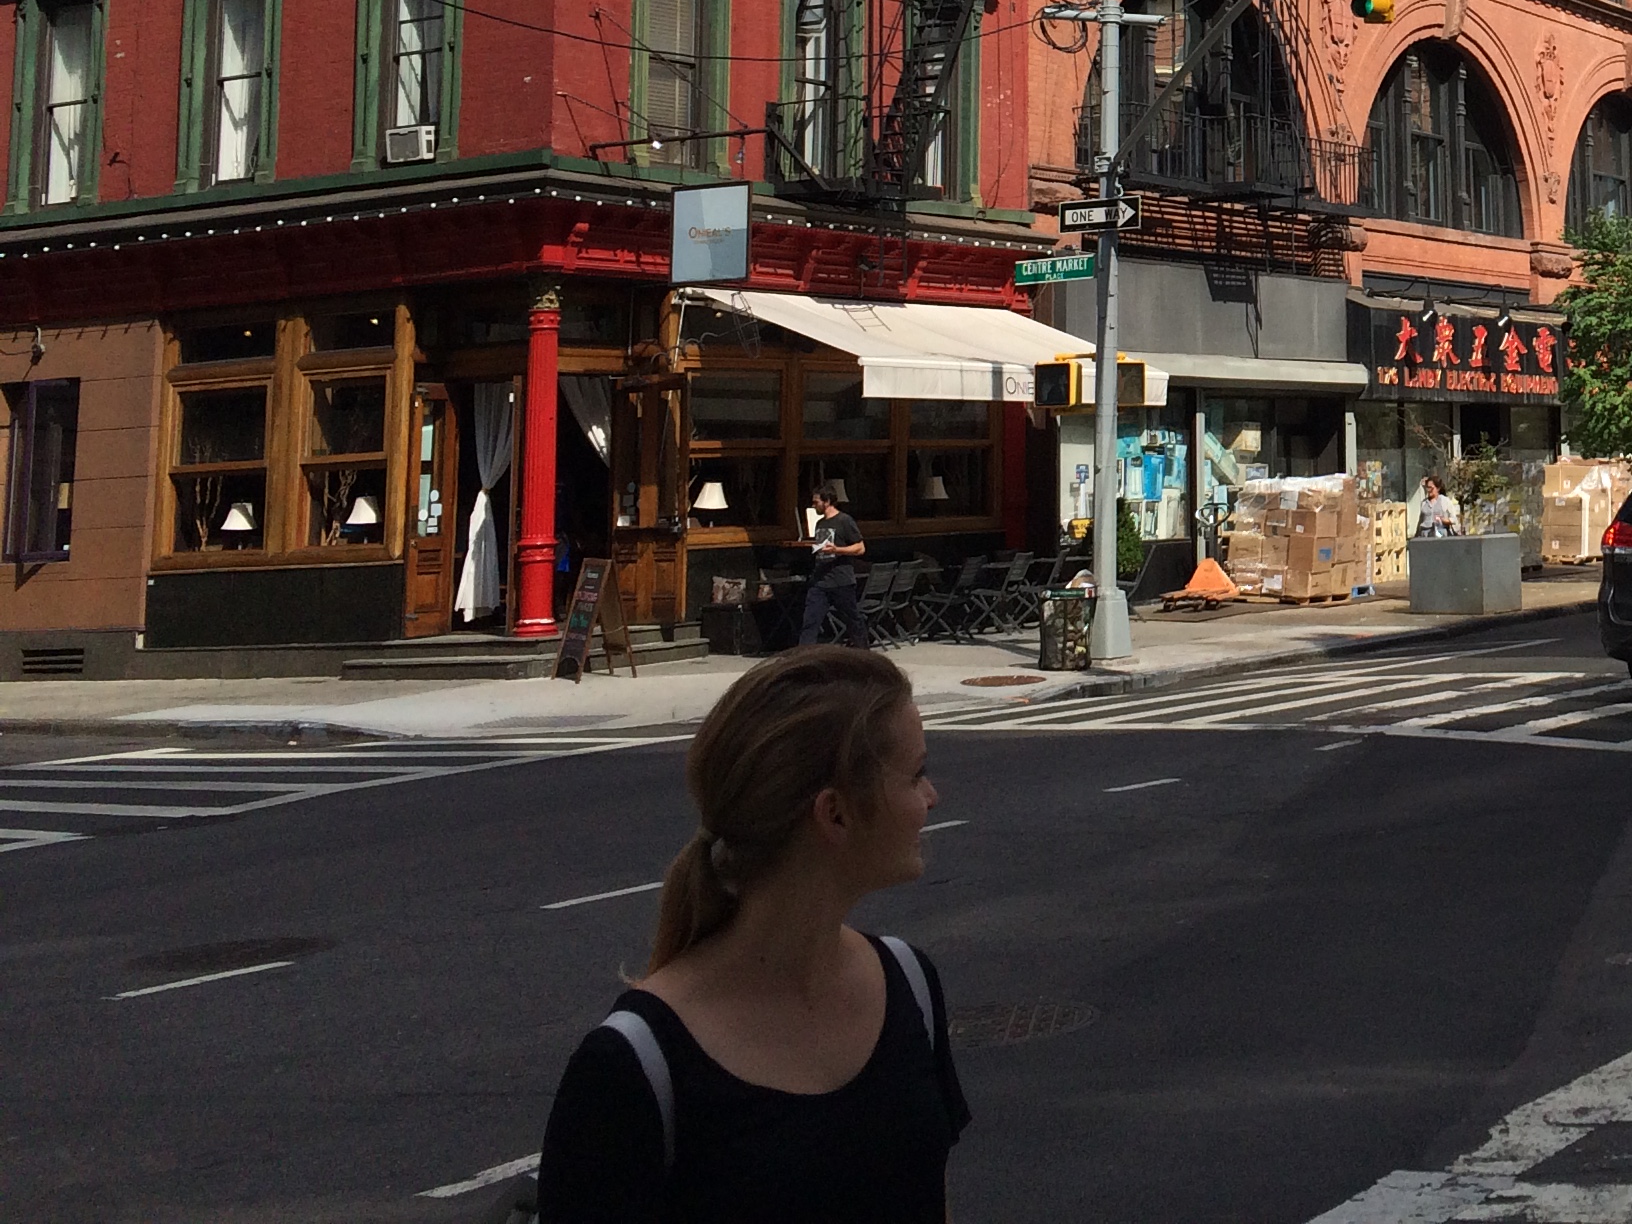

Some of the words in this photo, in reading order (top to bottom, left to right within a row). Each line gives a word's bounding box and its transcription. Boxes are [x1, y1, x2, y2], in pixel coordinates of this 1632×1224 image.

[1071, 210, 1094, 223] ONE
[1104, 207, 1128, 221] WAY
[1022, 261, 1053, 276] CENTRE
[1056, 257, 1089, 272] MARKET
[1045, 273, 1065, 281] PLACE
[1005, 376, 1035, 395] ONIE
[1377, 366, 1399, 385] 176
[1446, 369, 1497, 392] ELECTRIC
[1500, 372, 1559, 395] EQUIPMENT
